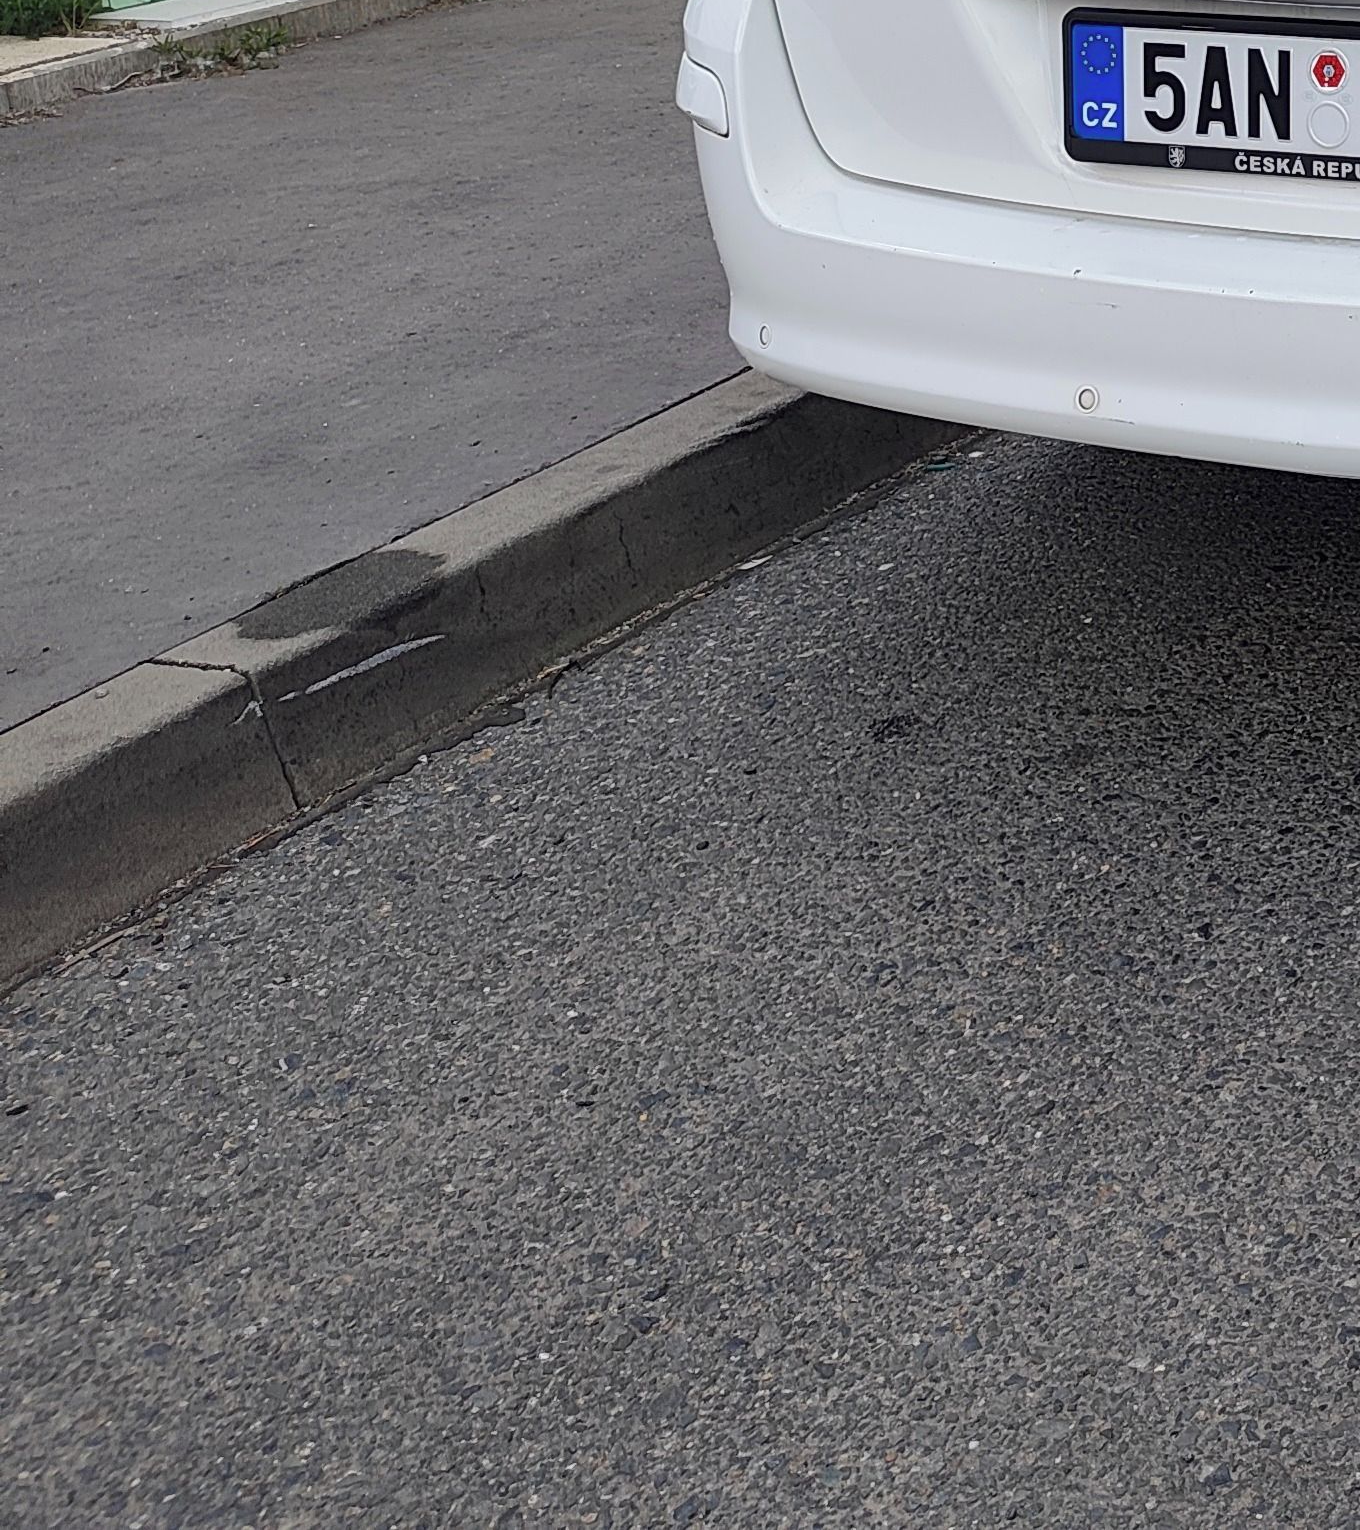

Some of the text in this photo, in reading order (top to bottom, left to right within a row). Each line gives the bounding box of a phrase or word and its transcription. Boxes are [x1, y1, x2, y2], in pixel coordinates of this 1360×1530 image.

[1143, 42, 1292, 141] 5AN
[1081, 100, 1118, 130] CZ
[1234, 151, 1305, 177] ČESKÁ
